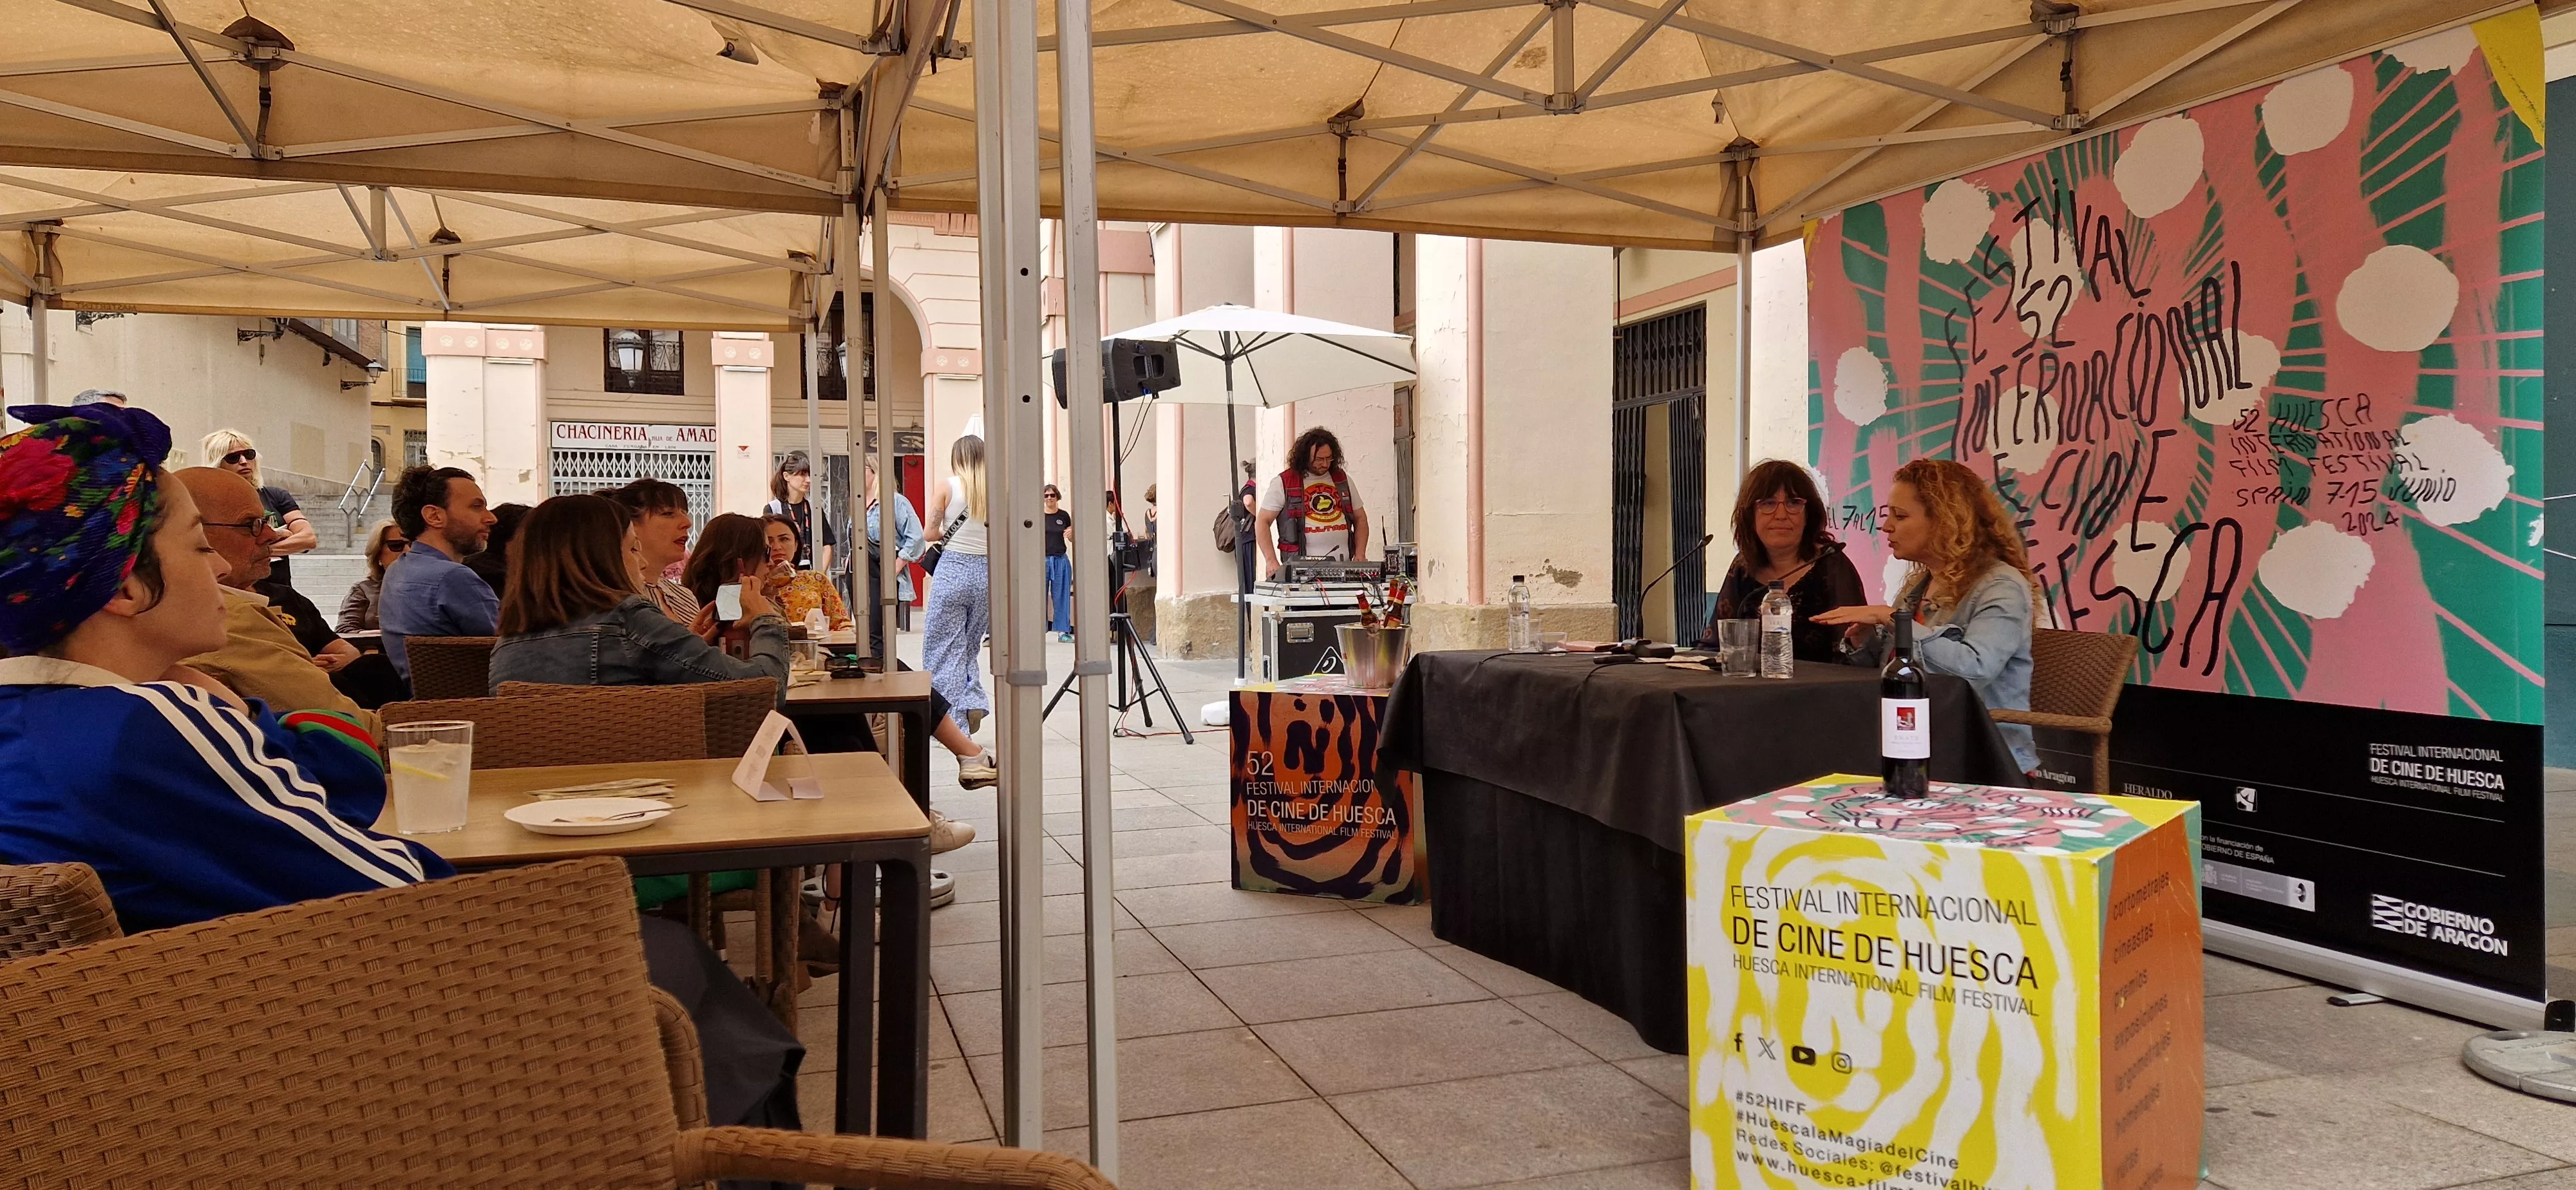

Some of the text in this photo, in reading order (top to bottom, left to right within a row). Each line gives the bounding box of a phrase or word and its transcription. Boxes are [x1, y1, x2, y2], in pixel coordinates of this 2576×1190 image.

[2012, 274, 2076, 357] 52
[2233, 393, 2373, 434] 52 HUESCA
[556, 424, 648, 440] CHACINERIA
[2229, 451, 2430, 478] FILM FESTIVAL
[2041, 429, 2177, 552] CINE
[2236, 481, 2312, 508] SPAIN
[2388, 469, 2457, 504] JUNIO
[2341, 511, 2400, 538] 2024
[1247, 751, 1274, 775] 52
[2369, 742, 2504, 762] FESTIVAL INTERNACIONAL
[1246, 781, 1299, 795] FESTIVAL
[2369, 757, 2505, 790] DE CINE DE HUESCA
[2370, 775, 2505, 803] HUESCA INTERNATIONAL FILM FESTIVAL
[2124, 782, 2173, 800] HERALDO
[1247, 799, 1397, 826] DE CINE DE HUESCA
[1247, 820, 1397, 840] HUESCA INTERNATIONAL FILM FESTIVAL
[2217, 837, 2254, 850] financiación
[2201, 843, 2275, 864] OBIERNO DE ESPAÑA
[1730, 885, 2038, 927] FESTIVAL INTERNACIONAL
[2113, 871, 2170, 921] cortometrajes
[2403, 902, 2495, 935] GOBIERNO
[1732, 916, 2040, 990] DE CINE DE HUESCA
[2113, 923, 2155, 965] cineastas
[2403, 918, 2509, 957] DE ARAGON
[1733, 953, 2040, 1018] HUESCA INTERNATIONAL FILM FESTIVAL
[2114, 968, 2148, 1014] premios
[1735, 1090, 1807, 1116] #52HIFF
[1735, 1109, 1959, 1169] #HuescalaMagiadelCine
[1736, 1128, 1995, 1190] Redes Sociales: @festivalh
